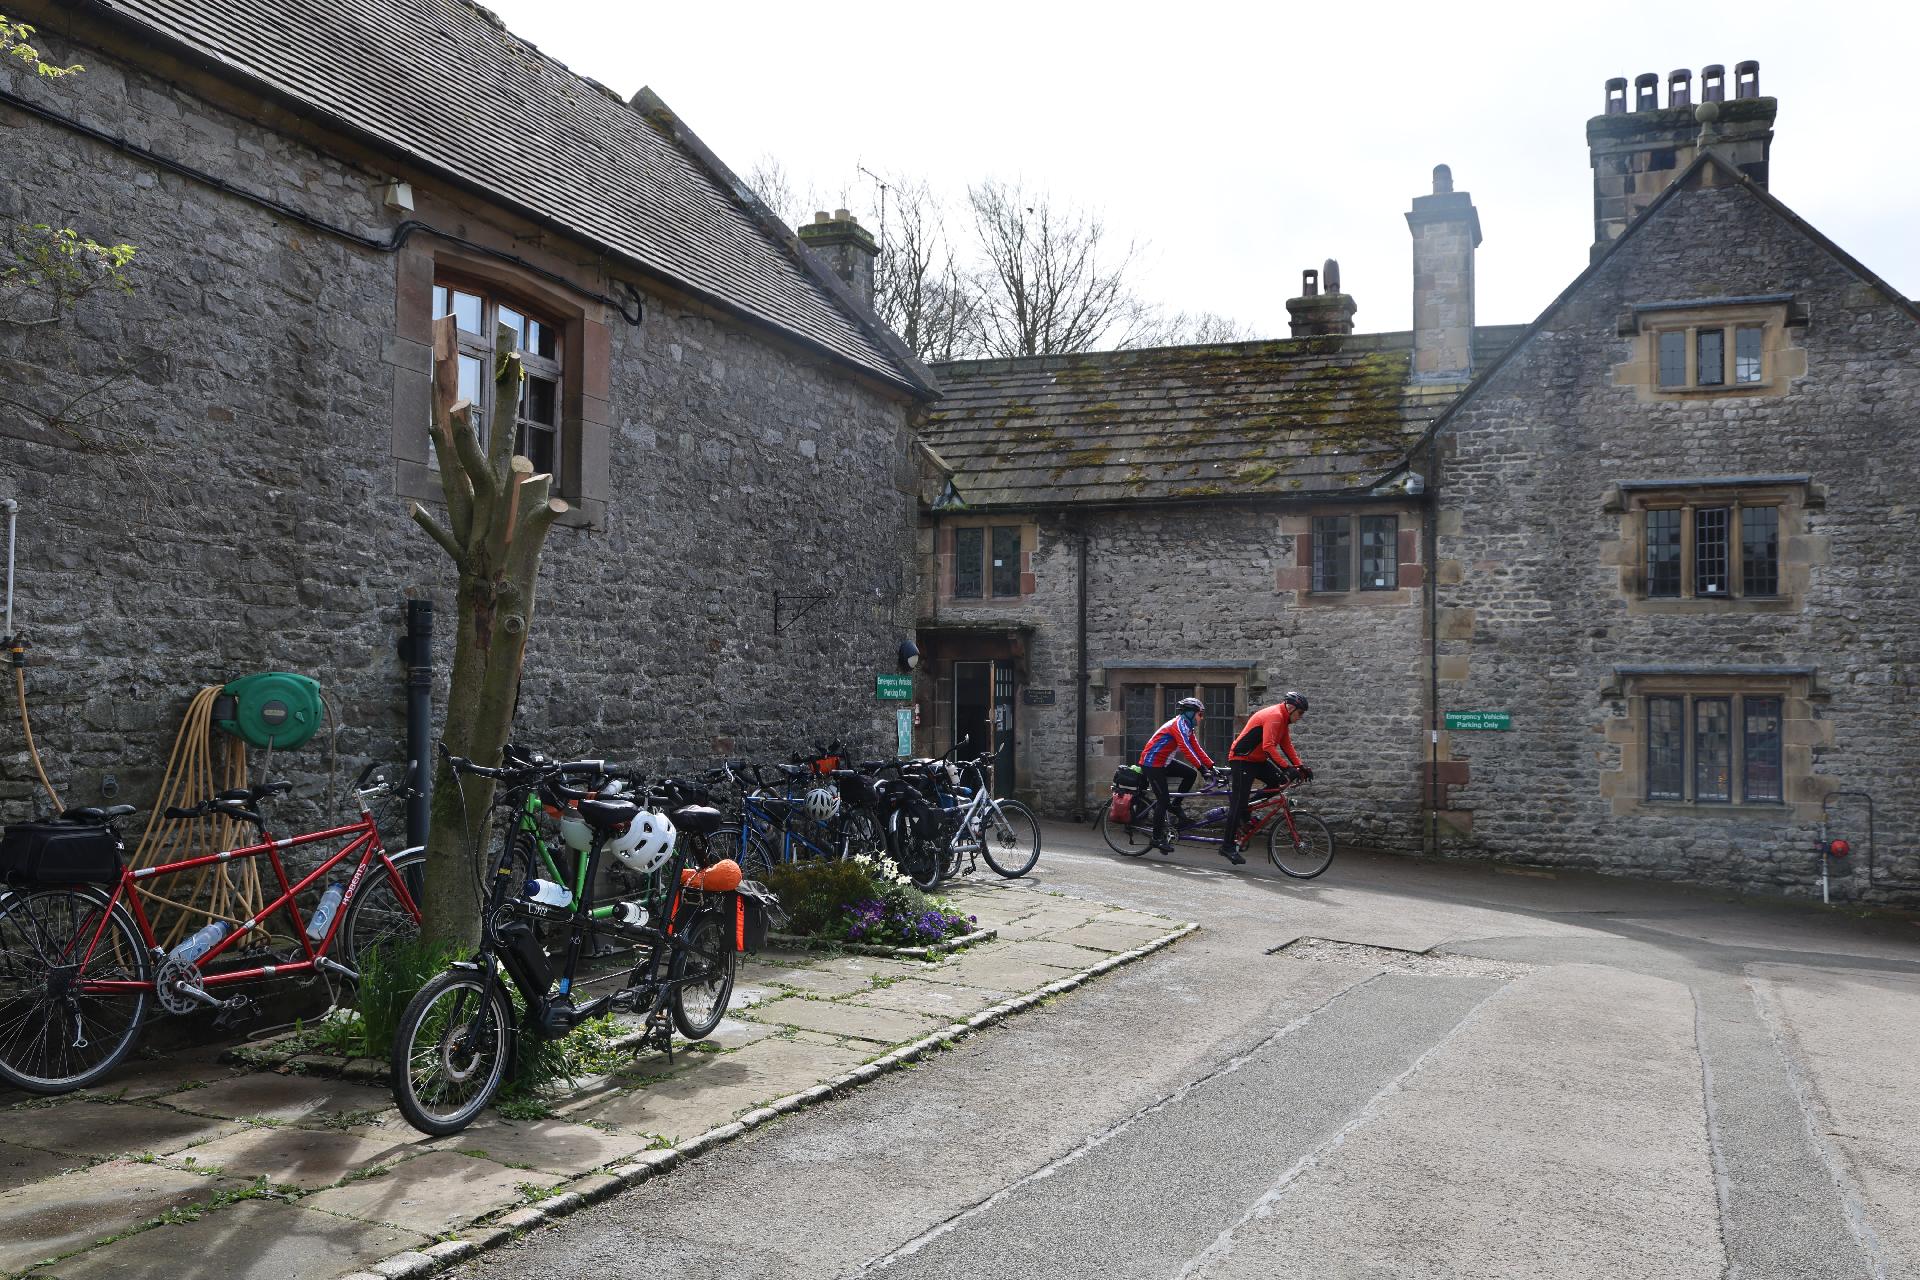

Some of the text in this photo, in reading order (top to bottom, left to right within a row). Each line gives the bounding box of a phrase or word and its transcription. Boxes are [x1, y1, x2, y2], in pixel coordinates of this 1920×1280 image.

[1446, 713, 1481, 721] Emergency
[1456, 721, 1499, 729] Parking Only
[342, 863, 367, 906] ROBERTS
